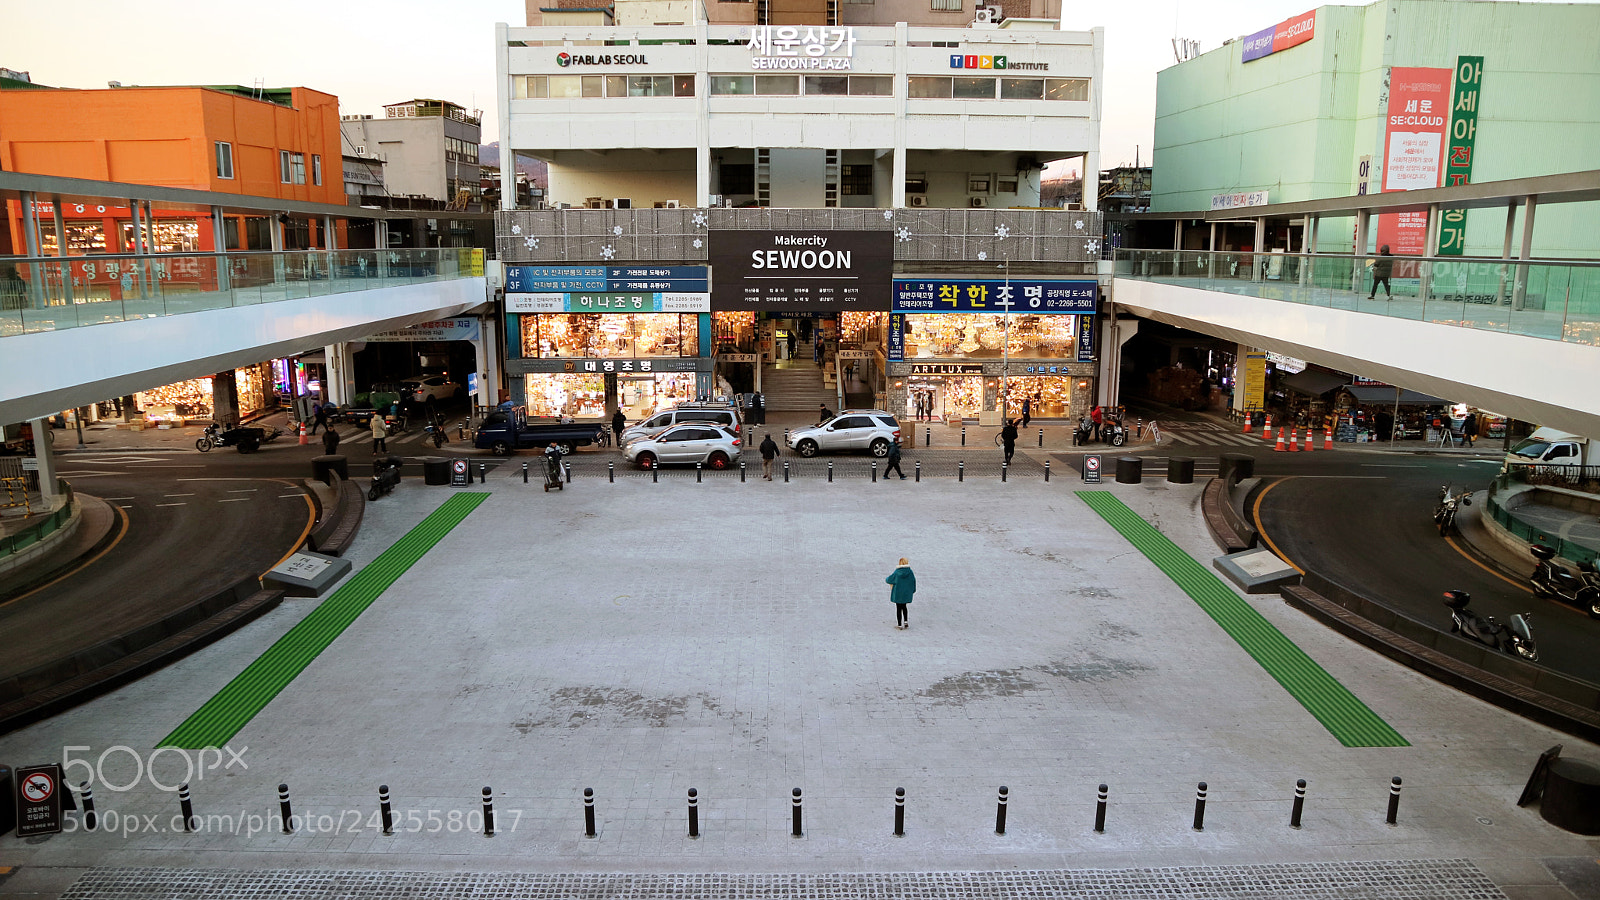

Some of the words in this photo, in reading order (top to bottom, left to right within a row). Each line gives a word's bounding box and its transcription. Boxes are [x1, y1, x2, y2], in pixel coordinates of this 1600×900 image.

[746, 26, 857, 57] 세운상가
[572, 55, 612, 66] FABLAB
[613, 54, 649, 65] SEOUL
[751, 57, 808, 70] SEWOON
[811, 57, 852, 70] PLAZA
[1007, 62, 1049, 71] INSTITUTE
[1405, 99, 1433, 114] 세운
[387, 107, 416, 120] 원룸텔
[1390, 115, 1444, 126] SE:CLOUD
[774, 235, 828, 248] Makercity
[751, 250, 852, 270] SEWOON
[509, 269, 520, 278] 4F
[509, 281, 520, 290] 3F
[585, 282, 604, 290] CCTV
[899, 291, 934, 300] 일반주택조명
[579, 295, 644, 310] 하나조명
[899, 300, 934, 308] 인테리어조명
[584, 360, 652, 373] 대영조명
[913, 365, 937, 374] ART
[940, 365, 964, 374] LUX
[26, 804, 51, 814] 오토바이
[26, 812, 51, 822] 진입금지
